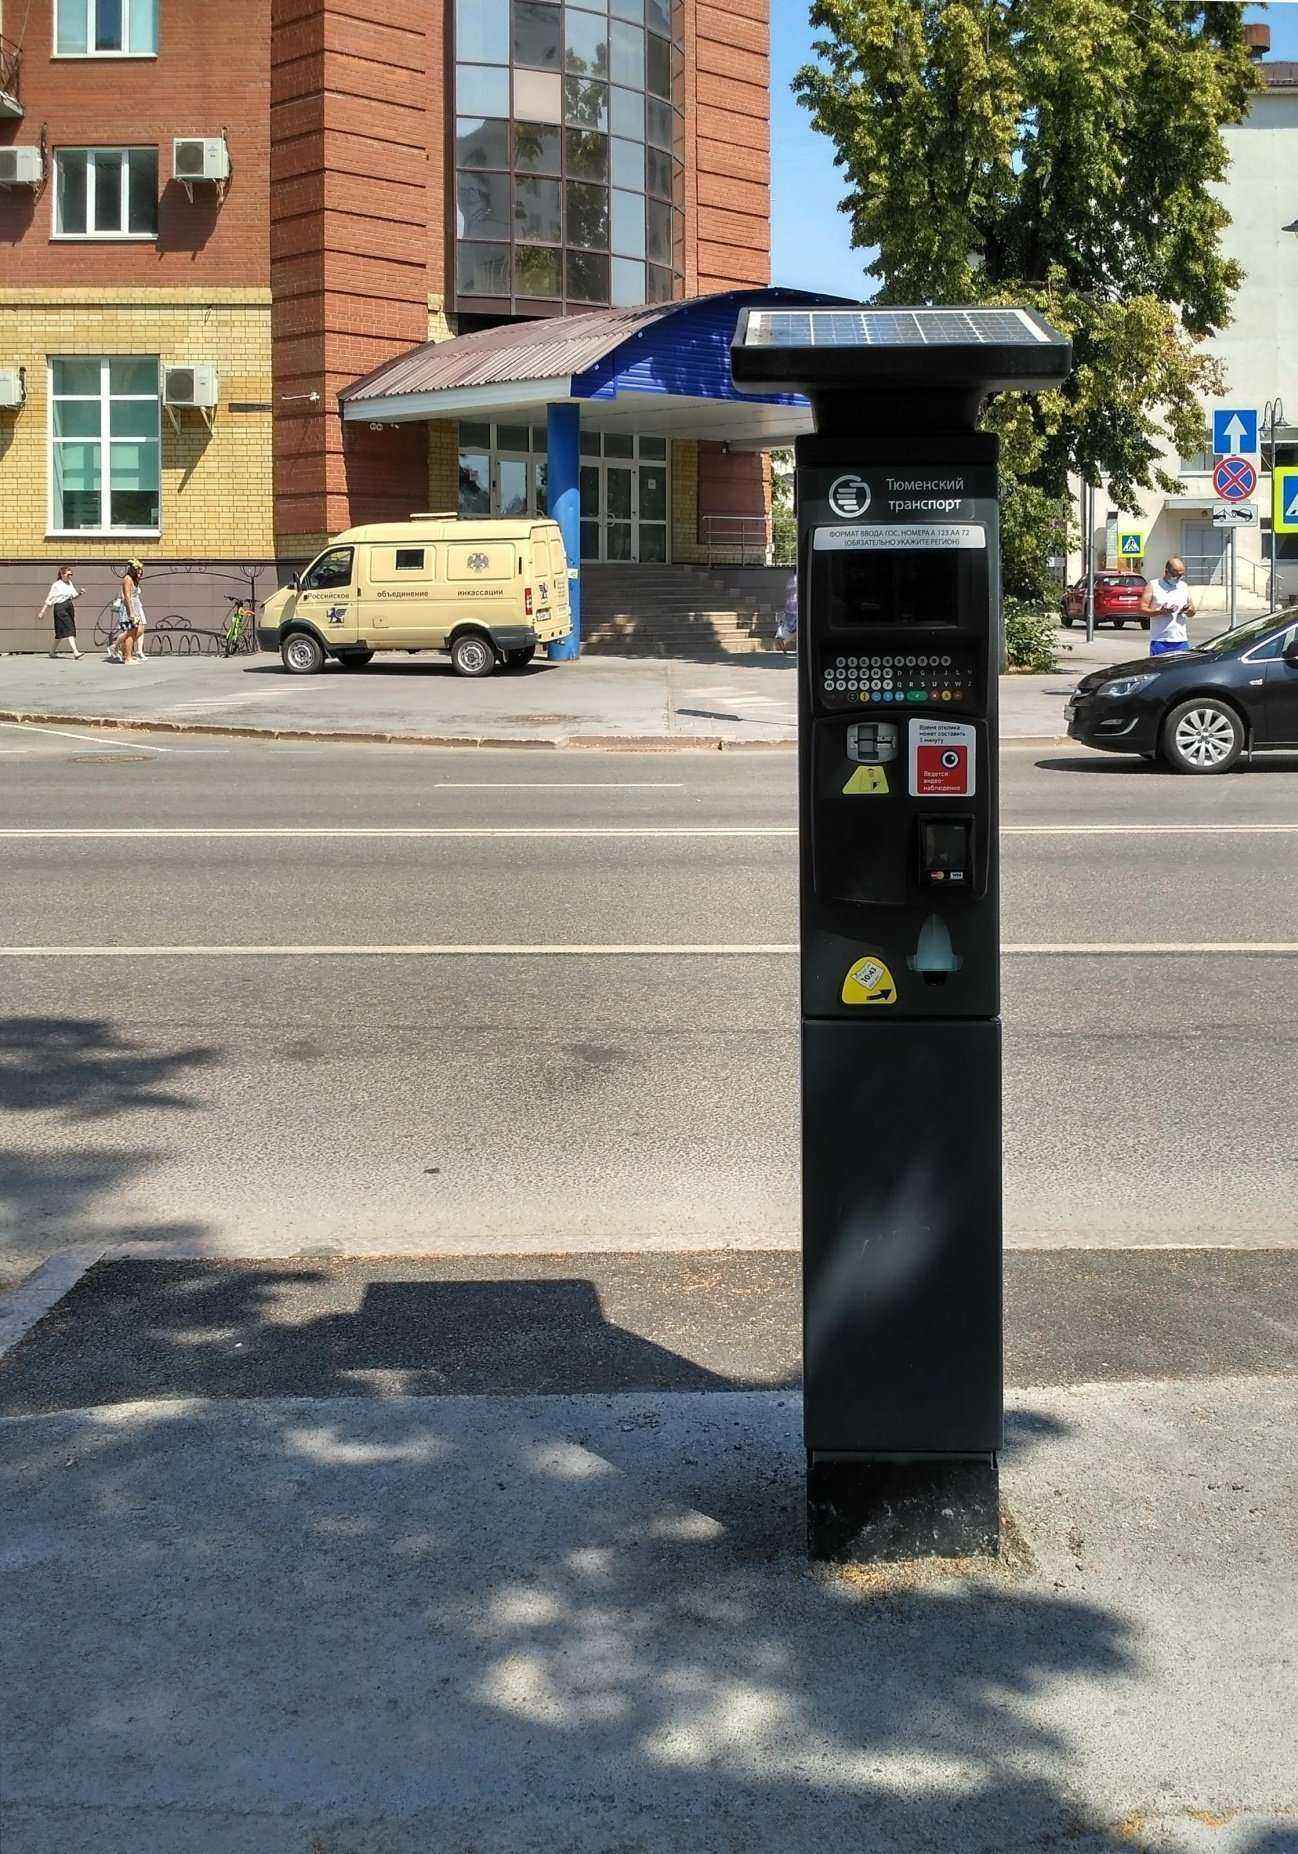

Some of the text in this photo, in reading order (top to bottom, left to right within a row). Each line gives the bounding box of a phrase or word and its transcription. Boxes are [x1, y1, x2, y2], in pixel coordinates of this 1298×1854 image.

[886, 477, 964, 491] Тюменский
[888, 499, 961, 512] транспорт
[901, 529, 929, 537] НОМЕРА
[896, 538, 930, 546] УКАЖИТЕ
[307, 589, 504, 600] Российское объединение инкассации
